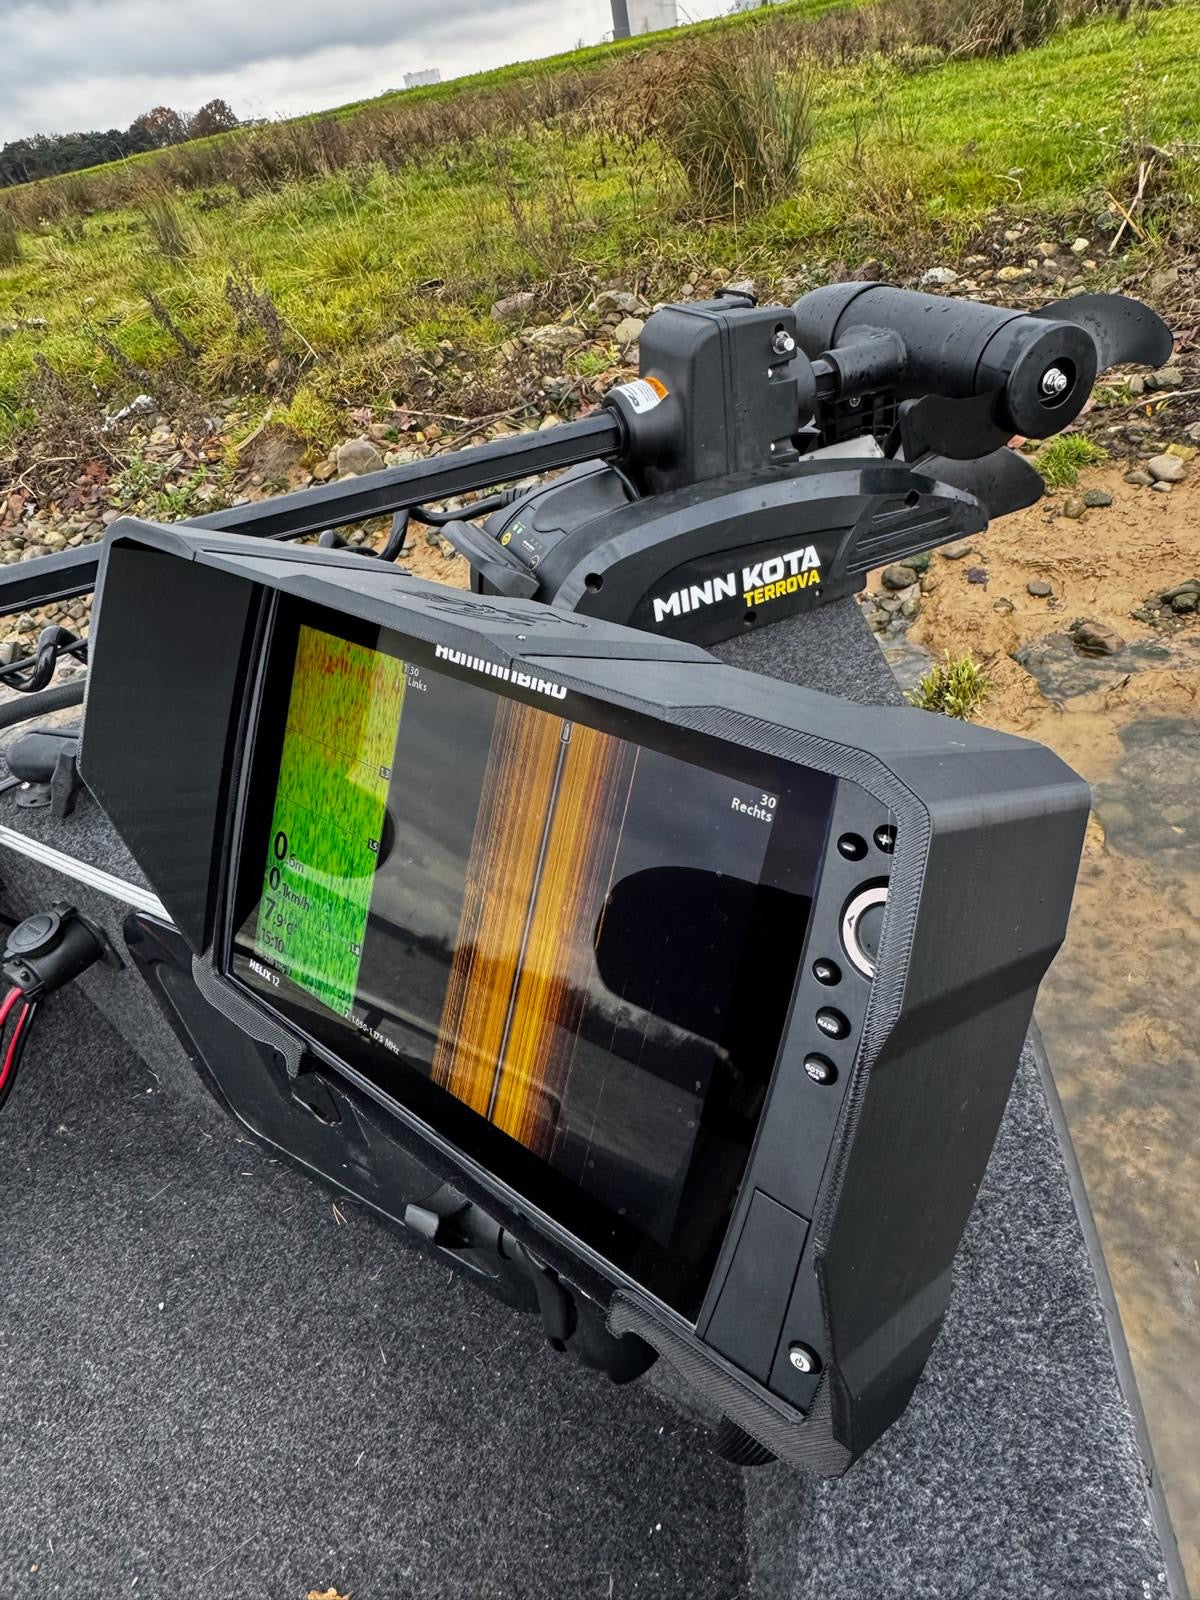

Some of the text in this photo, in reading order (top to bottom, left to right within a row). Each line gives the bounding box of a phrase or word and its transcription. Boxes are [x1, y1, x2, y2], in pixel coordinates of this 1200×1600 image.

[653, 545, 823, 623] MINN KOTA
[742, 570, 821, 608] TERROVA
[407, 677, 428, 692] Links
[731, 797, 773, 823] Rechts
[760, 794, 777, 809] 30
[249, 959, 271, 981] HELIX
[271, 975, 280, 987] 12
[817, 1018, 839, 1034] MARK
[804, 1063, 826, 1078] GOTO
